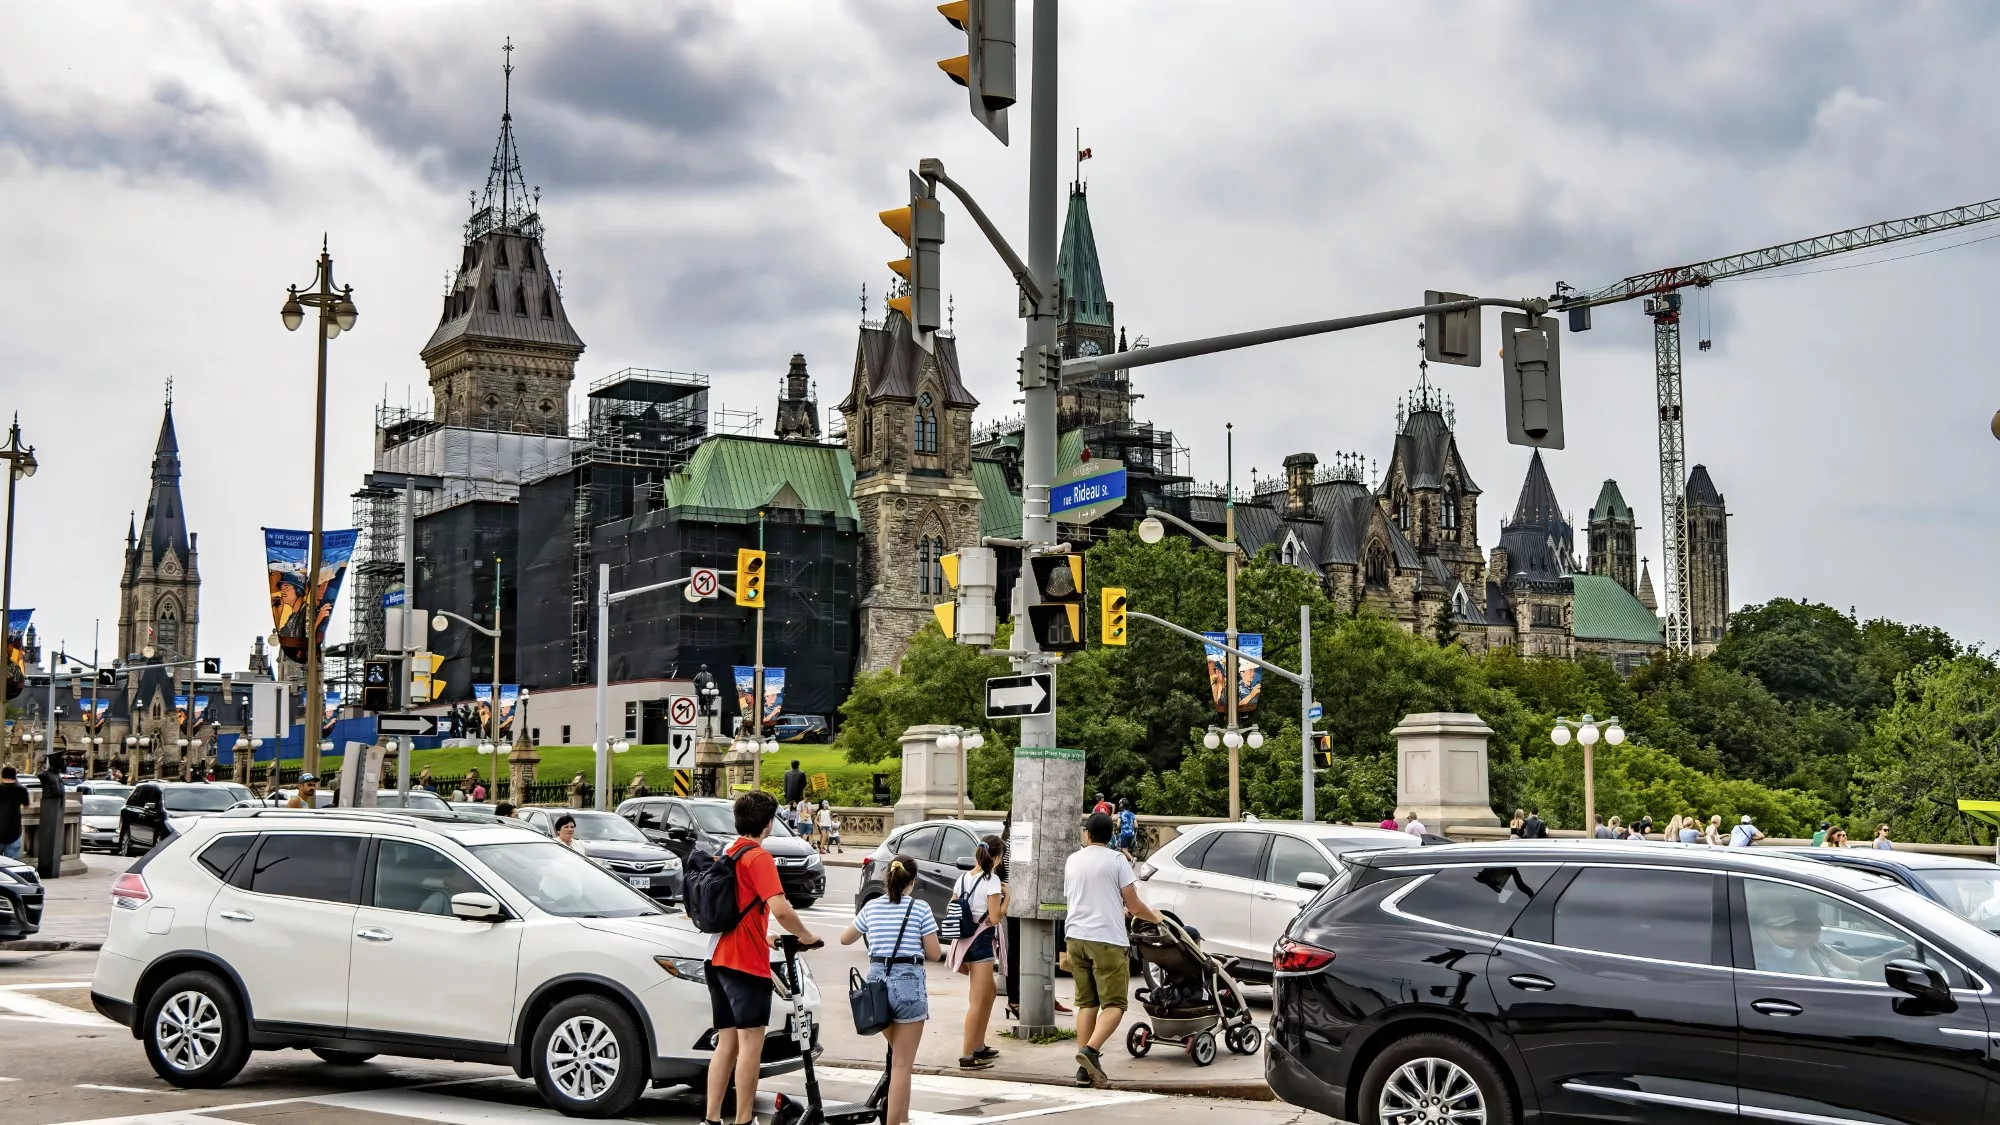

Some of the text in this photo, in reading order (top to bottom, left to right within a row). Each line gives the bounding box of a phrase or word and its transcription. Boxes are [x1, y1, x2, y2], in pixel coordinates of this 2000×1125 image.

[1073, 482, 1101, 503] Rideau
[1101, 484, 1109, 497] St.
[797, 1003, 808, 1038] BIRD
